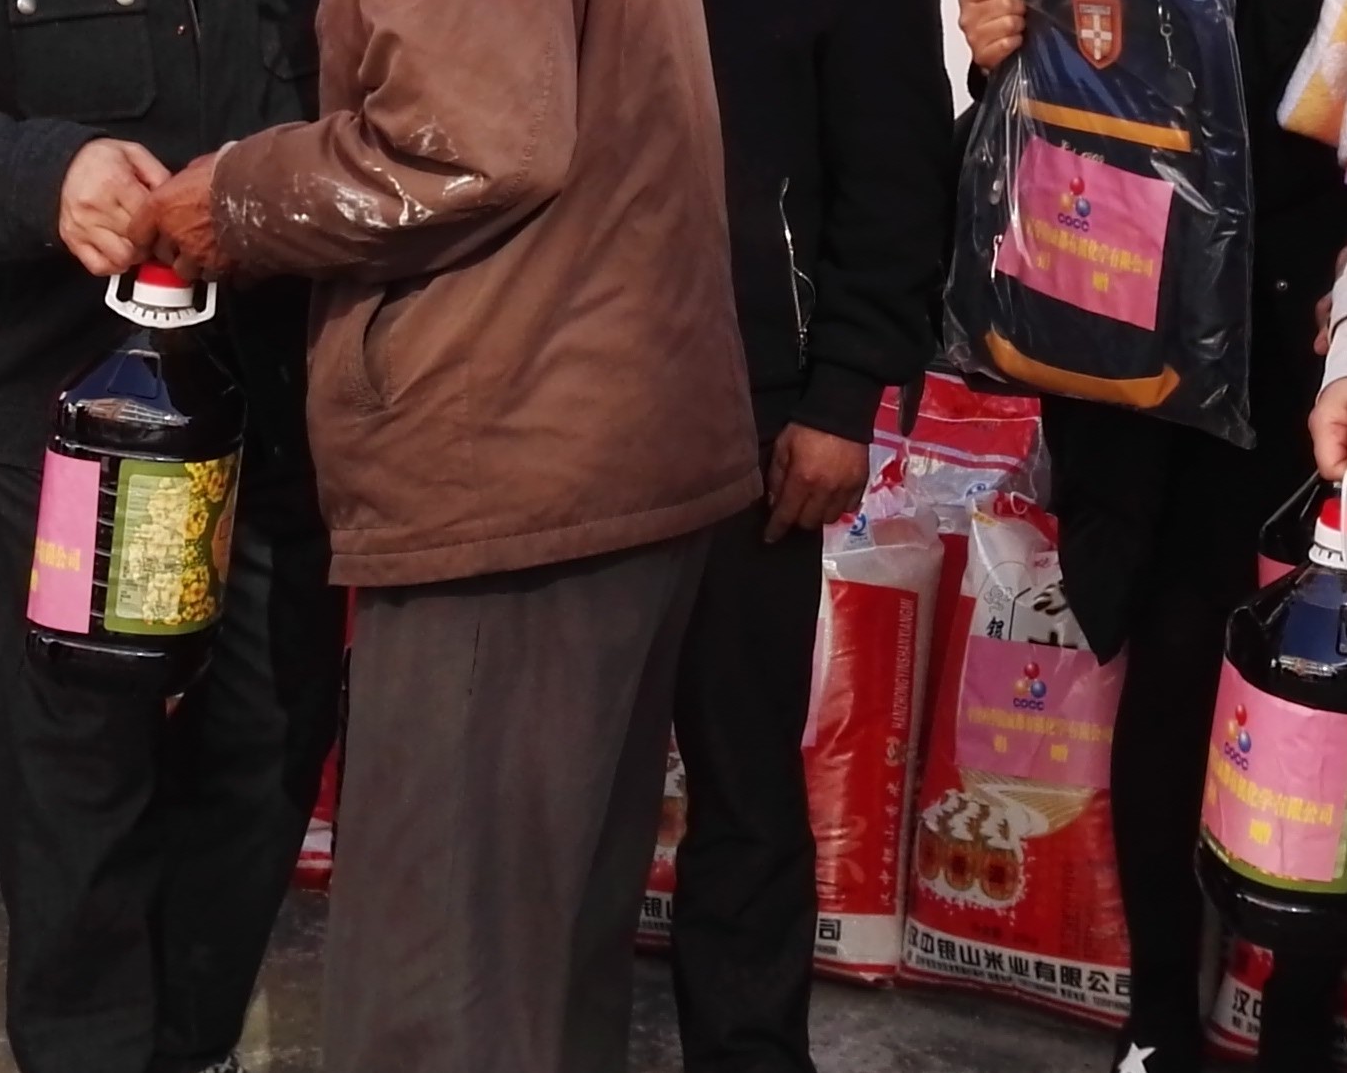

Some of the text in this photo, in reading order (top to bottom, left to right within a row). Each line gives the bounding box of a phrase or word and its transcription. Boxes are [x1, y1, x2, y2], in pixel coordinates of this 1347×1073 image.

[1057, 213, 1090, 232] COCC
[1013, 697, 1044, 711] COCC
[818, 918, 842, 941] 司
